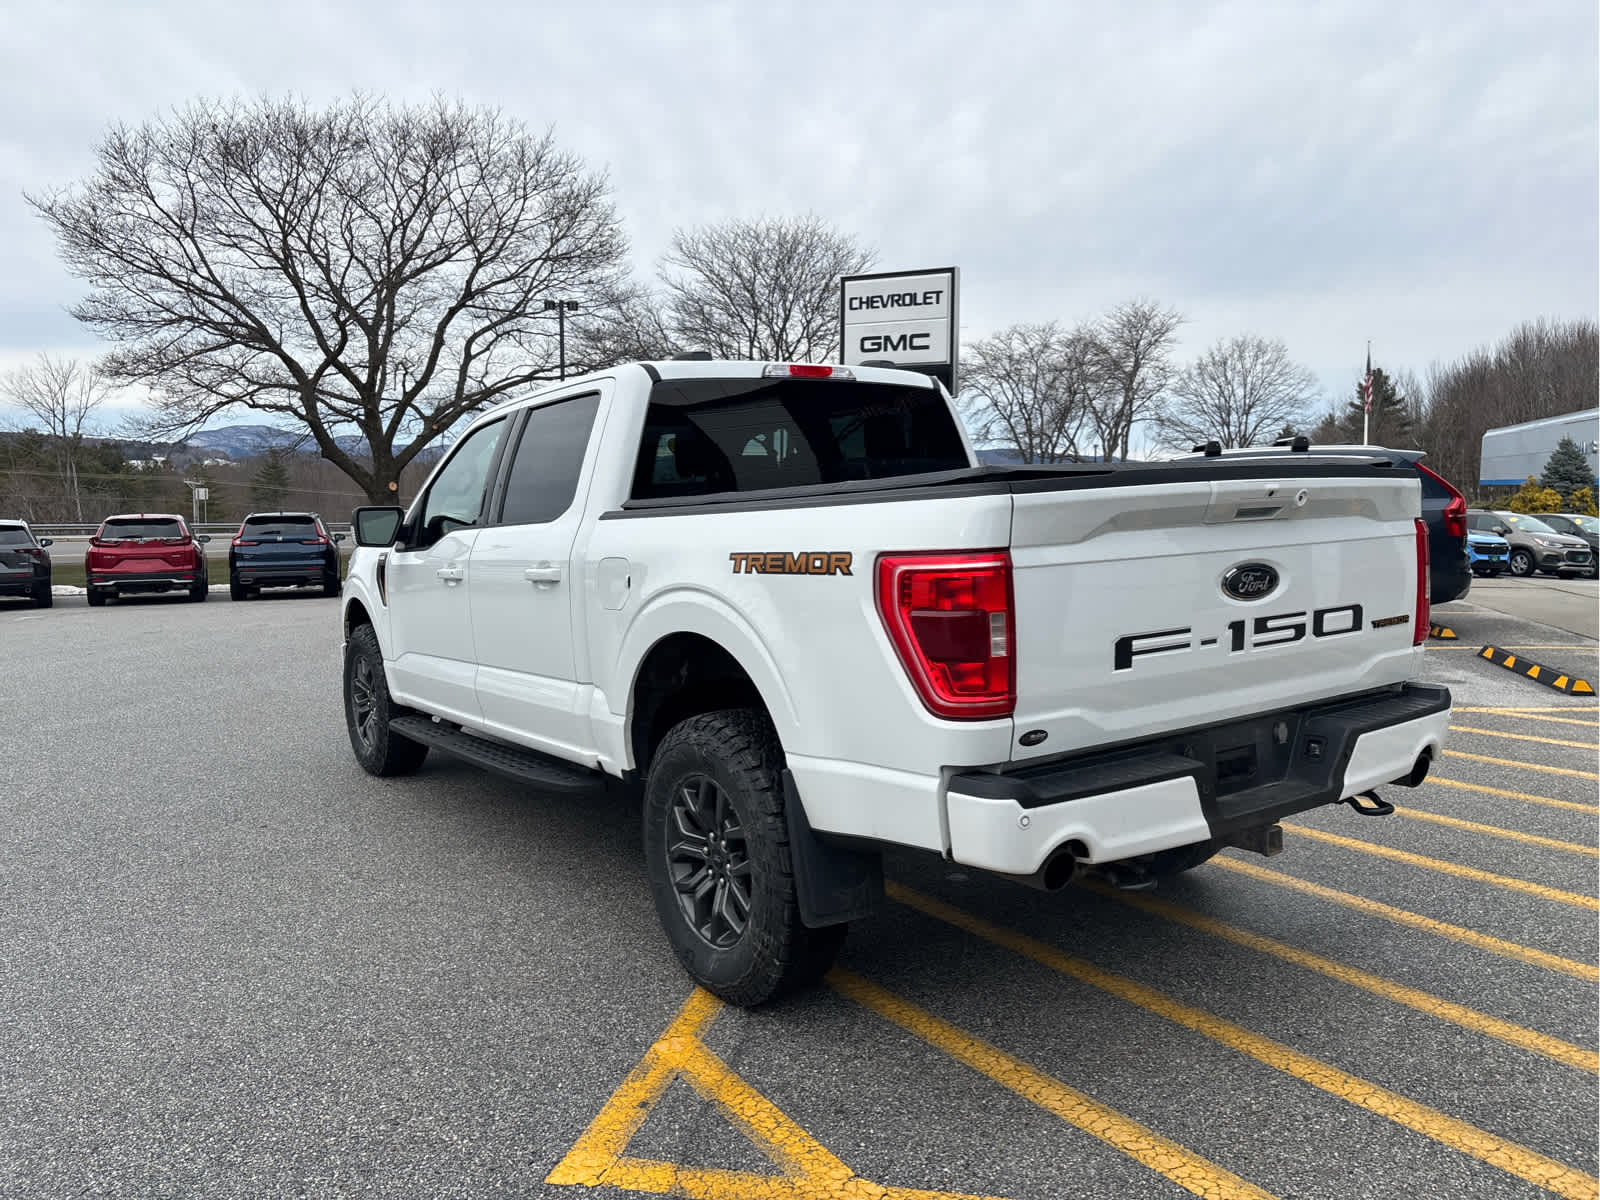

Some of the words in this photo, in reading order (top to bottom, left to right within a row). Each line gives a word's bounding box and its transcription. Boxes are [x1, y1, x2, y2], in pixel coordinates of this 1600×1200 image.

[848, 290, 944, 311] CHEVROLET
[860, 332, 930, 353] GMC
[729, 551, 854, 576] TREMOR
[1239, 571, 1270, 593] Ford
[1113, 604, 1363, 671] F-150
